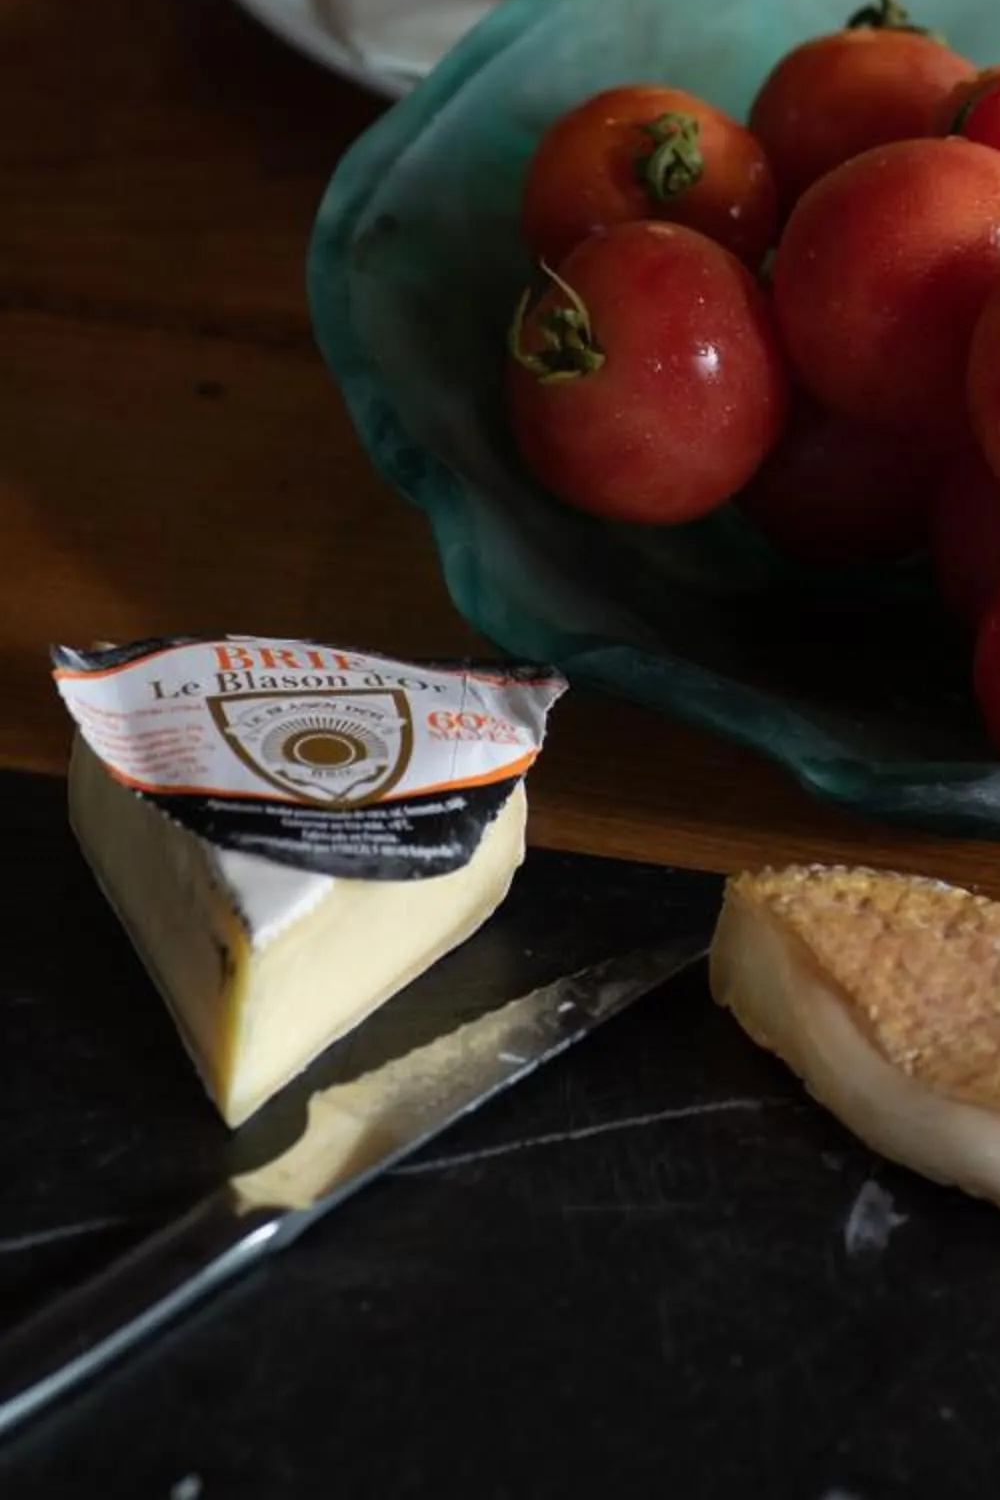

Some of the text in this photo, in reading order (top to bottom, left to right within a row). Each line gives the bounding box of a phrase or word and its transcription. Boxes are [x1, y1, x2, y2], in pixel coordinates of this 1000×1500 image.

[213, 644, 370, 671] BRIE
[148, 671, 448, 700] Le Blason d'Or
